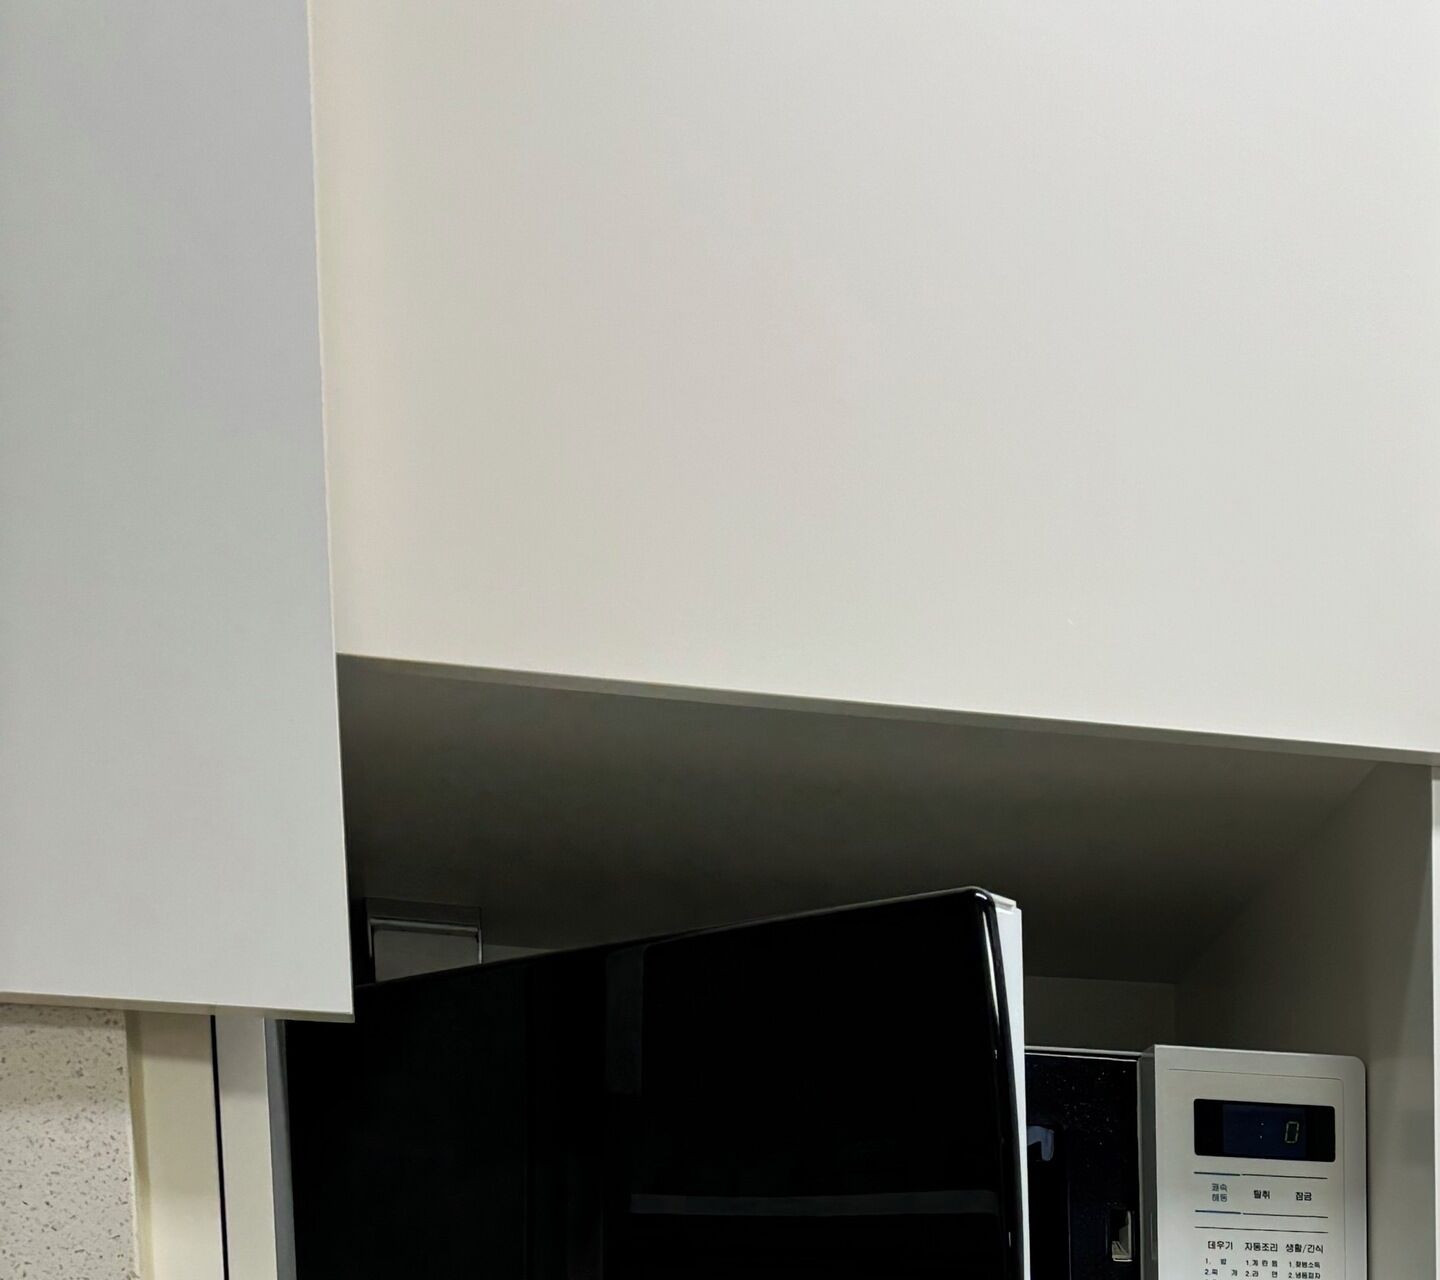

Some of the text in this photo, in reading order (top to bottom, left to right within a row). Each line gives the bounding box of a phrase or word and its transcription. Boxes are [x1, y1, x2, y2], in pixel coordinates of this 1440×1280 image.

[1296, 1192, 1312, 1201] 잠금
[1208, 1240, 1234, 1250] 데우기
[1244, 1242, 1278, 1252] 자동조리
[1286, 1244, 1324, 1254] 생활/간식
